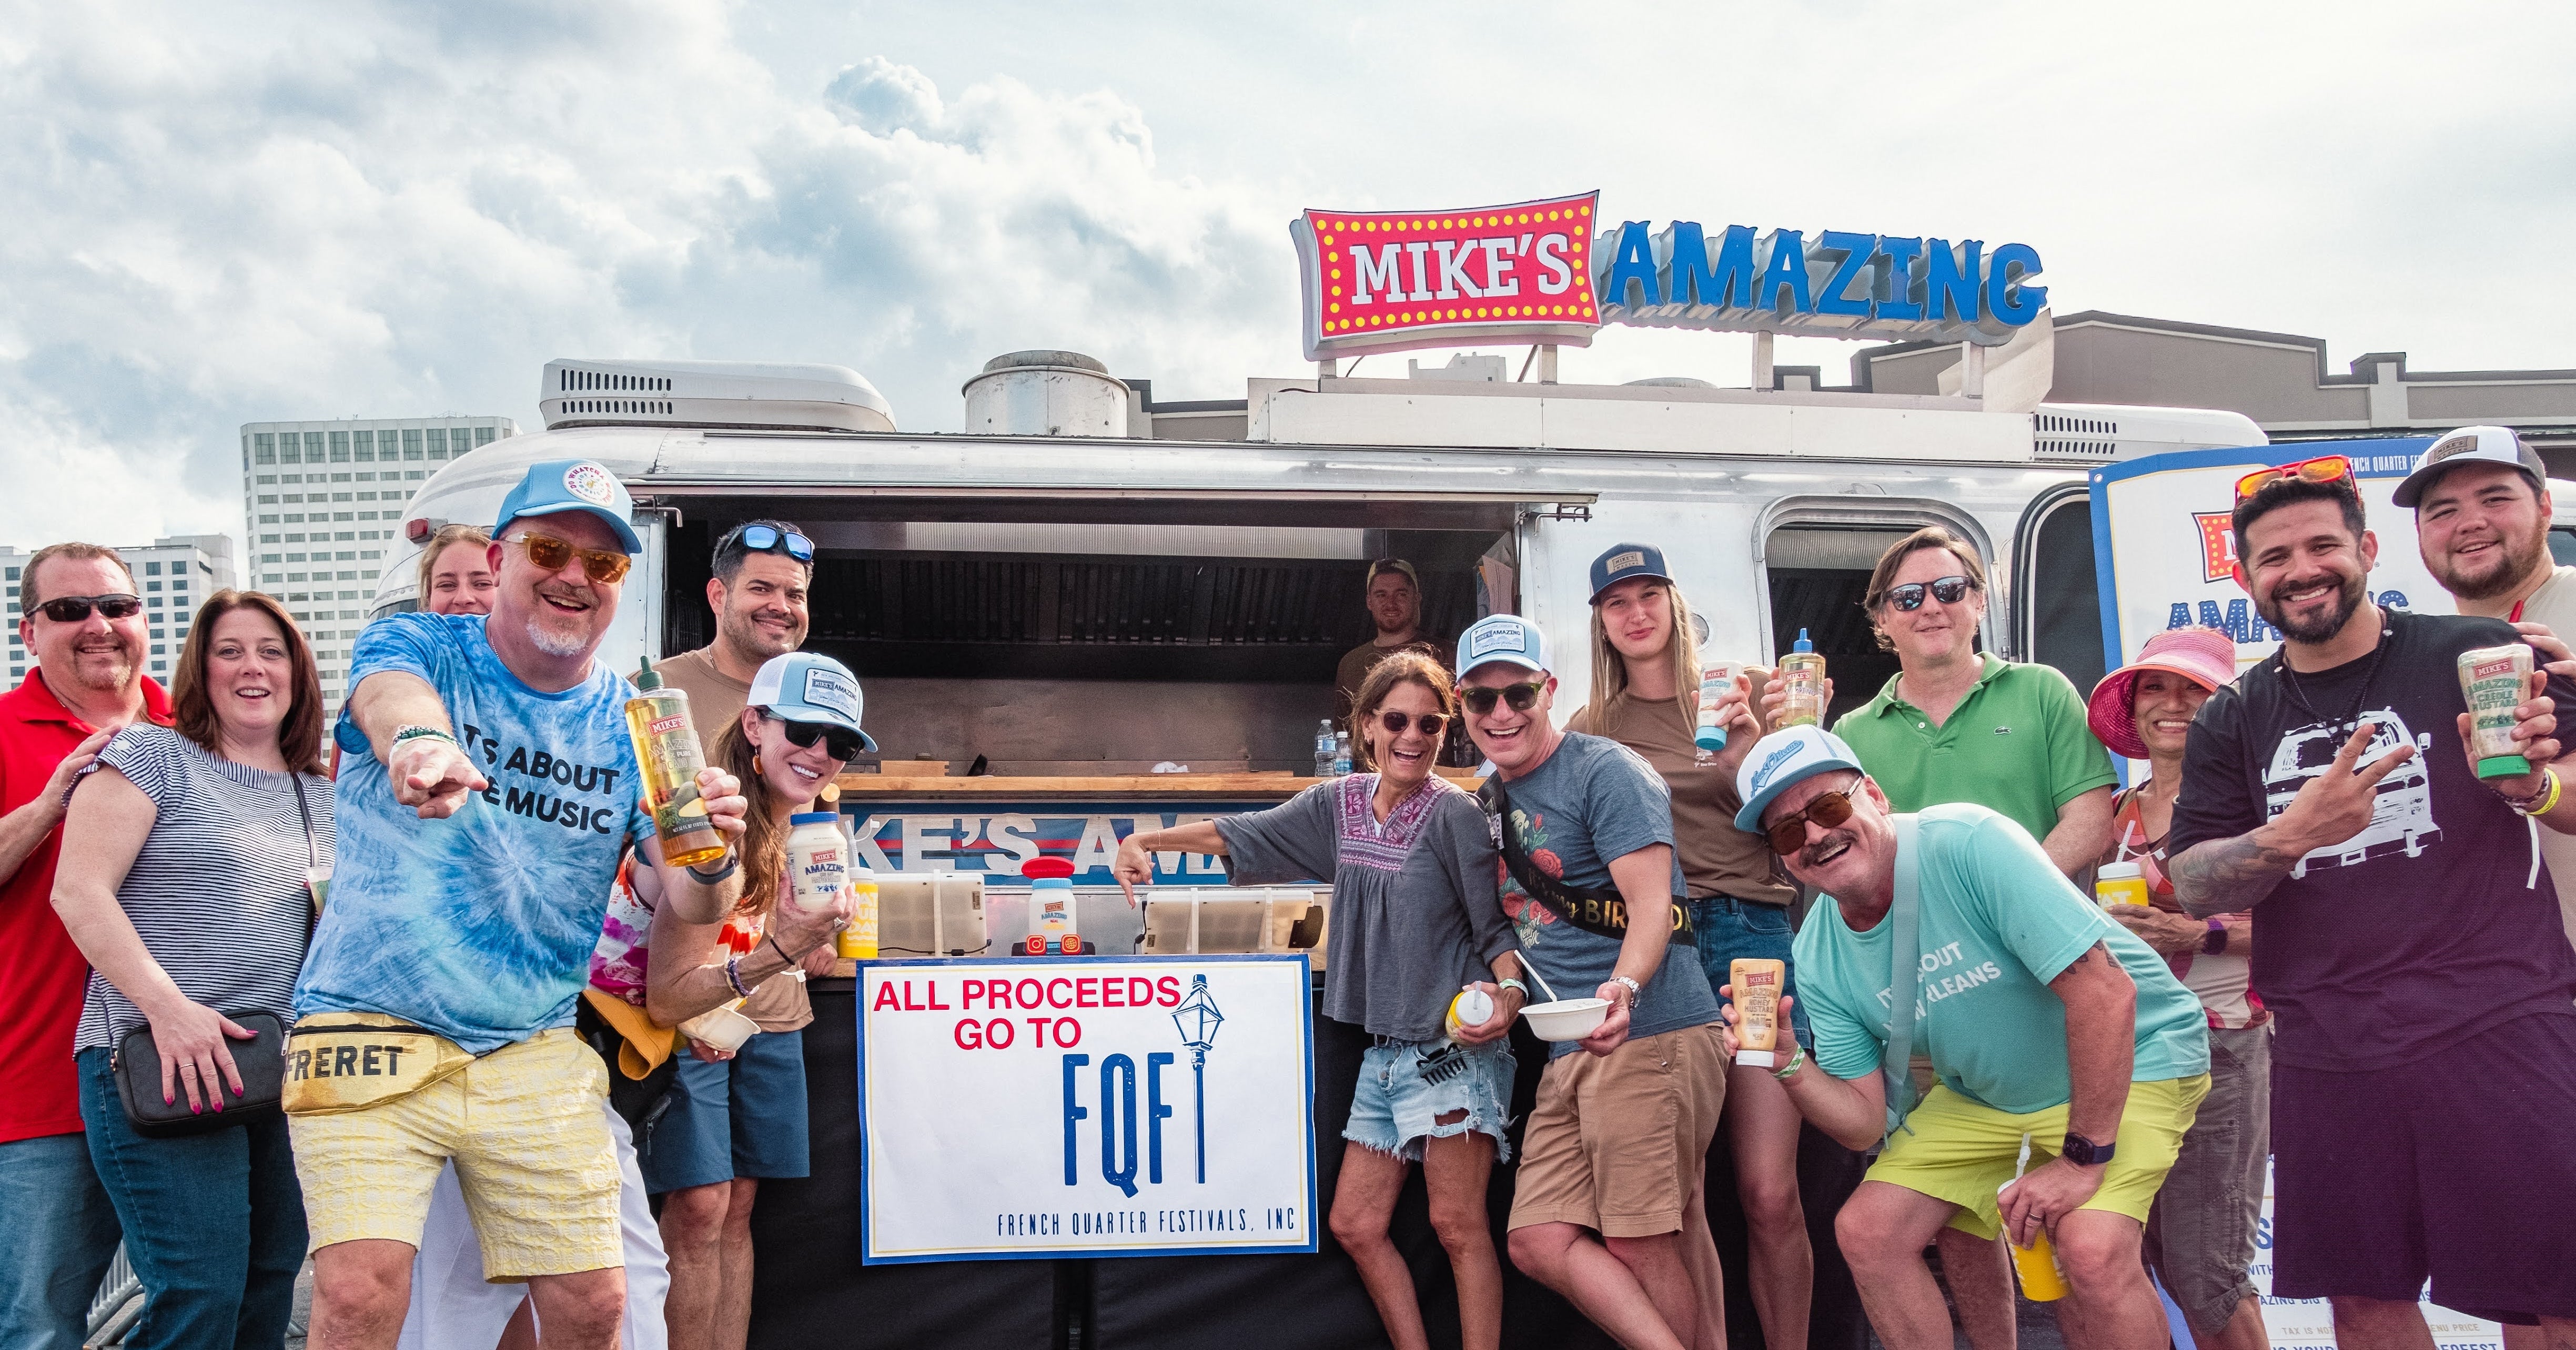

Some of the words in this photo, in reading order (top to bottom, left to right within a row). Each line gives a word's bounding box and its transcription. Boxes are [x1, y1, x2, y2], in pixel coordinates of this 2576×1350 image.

[1349, 232, 1572, 305] MIKE'S
[1606, 220, 2048, 327] AMAZING
[2348, 457, 2370, 472] ENCH
[2372, 455, 2407, 472] QUARTER
[1615, 555, 1634, 564] MIKE'S
[1786, 672, 1810, 681] MIKE'S
[2478, 662, 2509, 676] MIKE'S
[834, 684, 857, 701] AMAZING
[2467, 678, 2523, 696] AMAZING
[2472, 698, 2519, 712] MUSTARD
[2477, 691, 2513, 702] CREOLE
[652, 718, 684, 734] MIKE'S
[503, 746, 620, 795] ABOUT
[506, 787, 614, 835] MUSIC
[840, 813, 1040, 877] KE'S
[814, 852, 835, 861] MIKE'S
[805, 864, 844, 876] AMAZING
[1749, 975, 1772, 983] MIKE'S
[873, 980, 949, 1011] ALL
[963, 976, 1181, 1010] PROCEEDS
[1739, 988, 1779, 999] AMAZING
[954, 1018, 1014, 1050] GO
[1027, 1017, 1082, 1048] TO
[285, 1045, 403, 1084] FRERET
[1062, 1051, 1174, 1199] FQF
[998, 1213, 1059, 1236] FRENCH
[1072, 1211, 1146, 1235] QUARTER
[1159, 1209, 1254, 1233] FESTIVALS,
[1267, 1207, 1295, 1230] INC
[2453, 1323, 2480, 1332] PRICE
